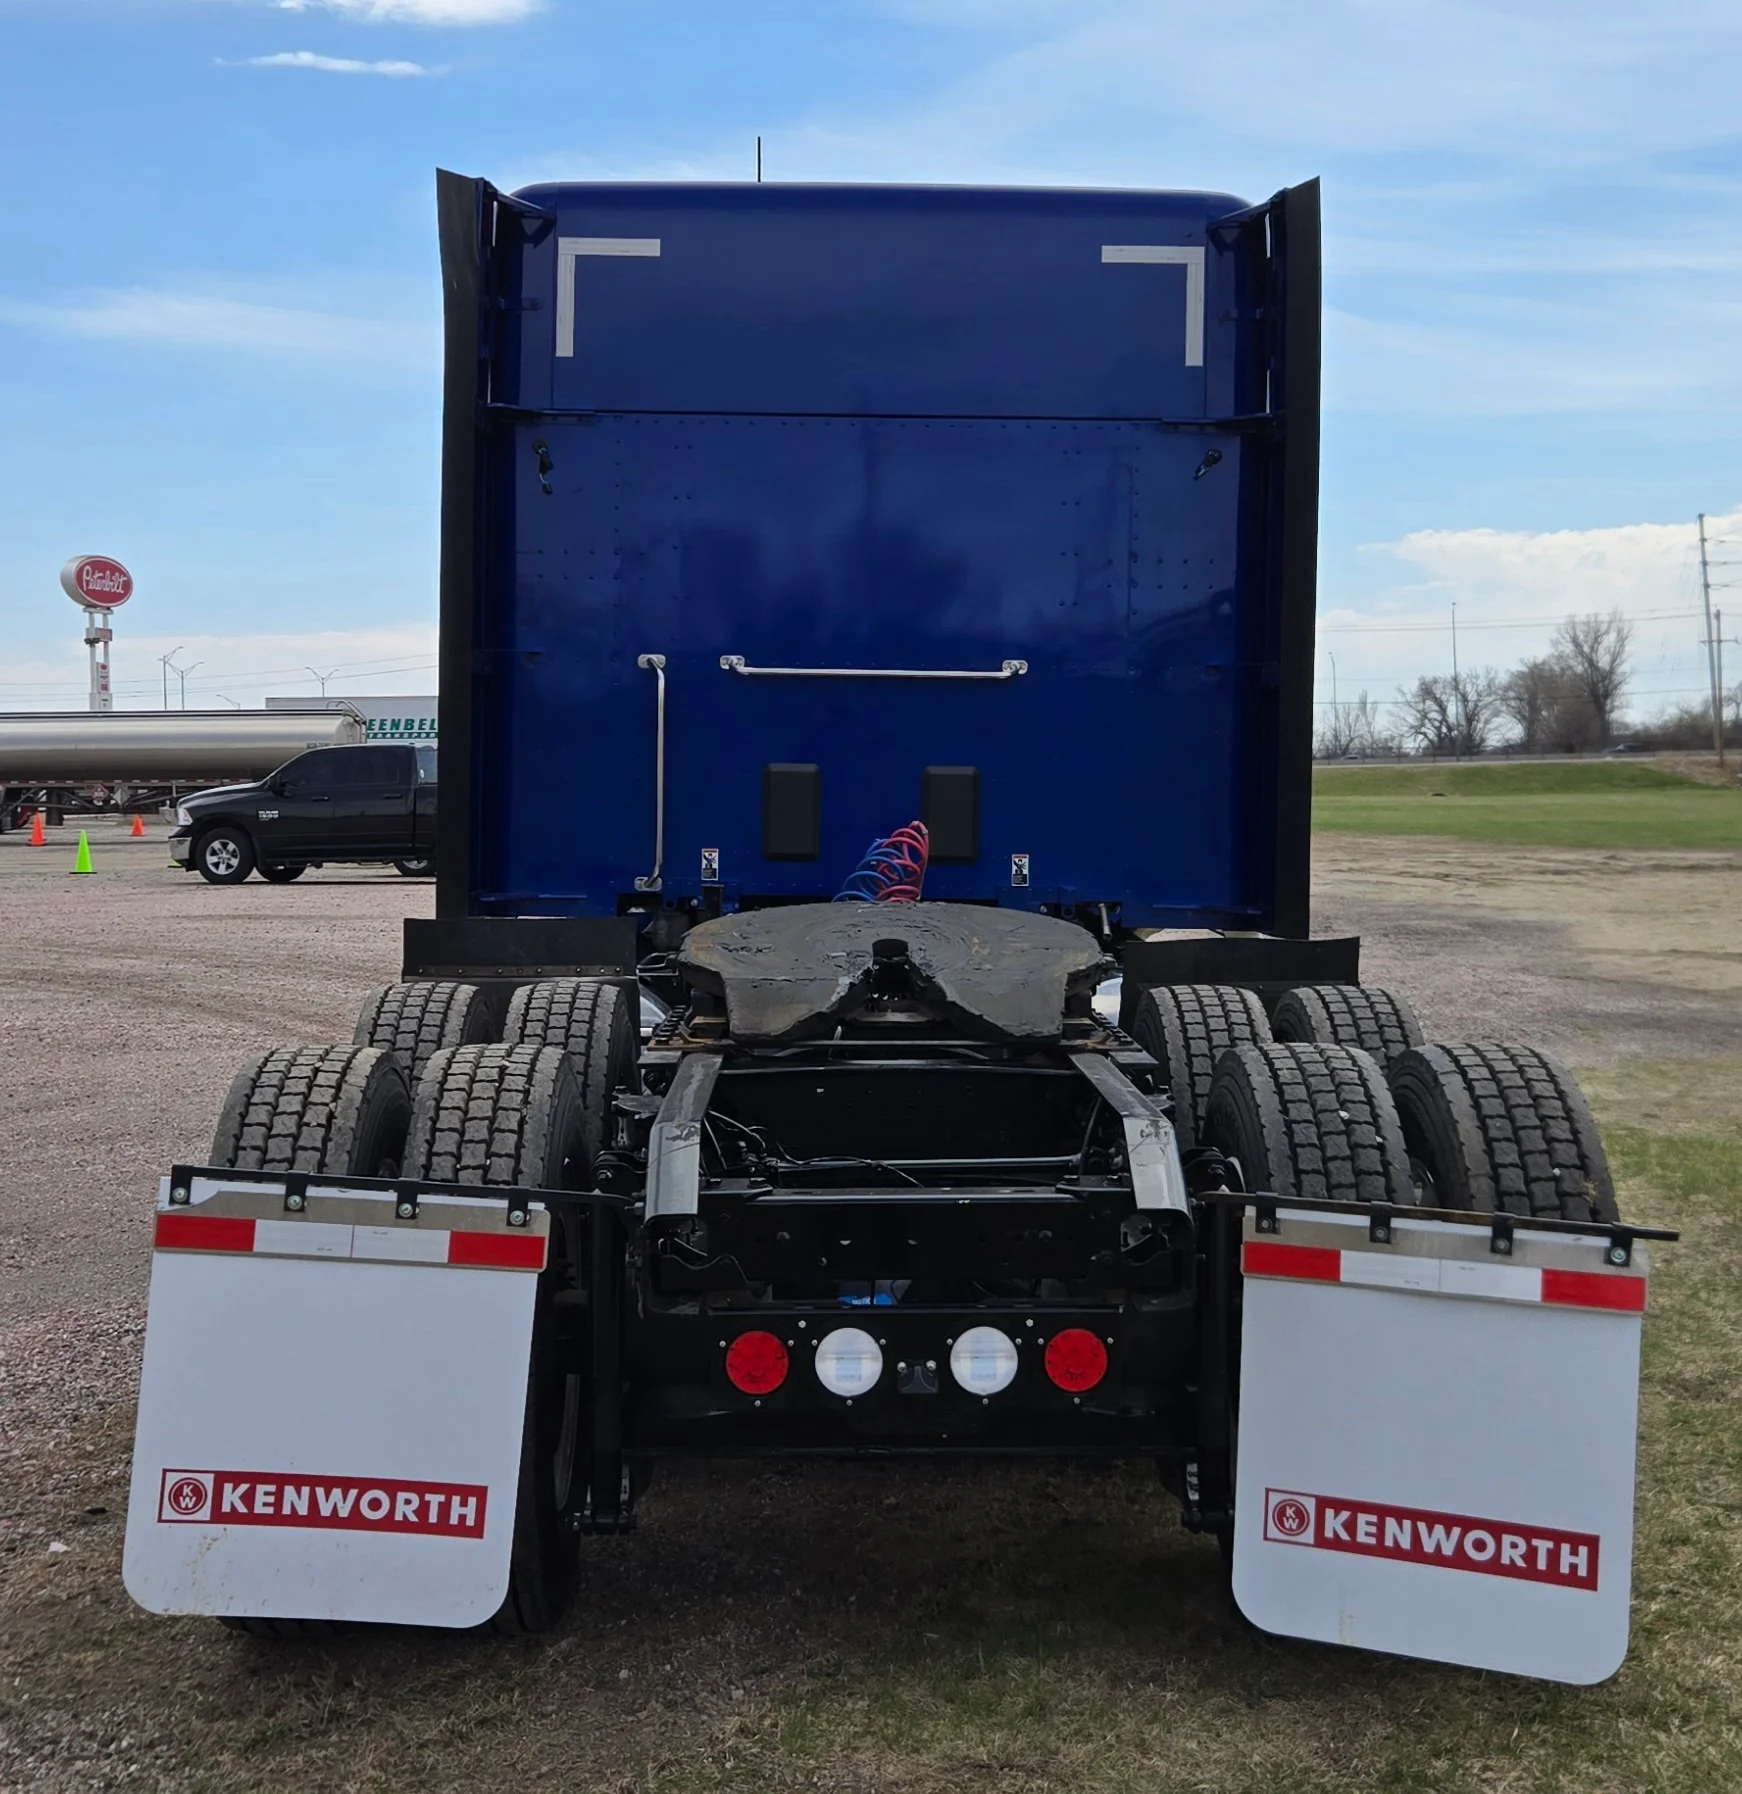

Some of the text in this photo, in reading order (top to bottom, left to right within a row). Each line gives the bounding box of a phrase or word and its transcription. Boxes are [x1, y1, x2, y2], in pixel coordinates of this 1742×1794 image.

[83, 565, 127, 593] Peterbilt
[221, 1482, 477, 1527] KENWORTH
[1324, 1507, 1588, 1577] KENWORTH
